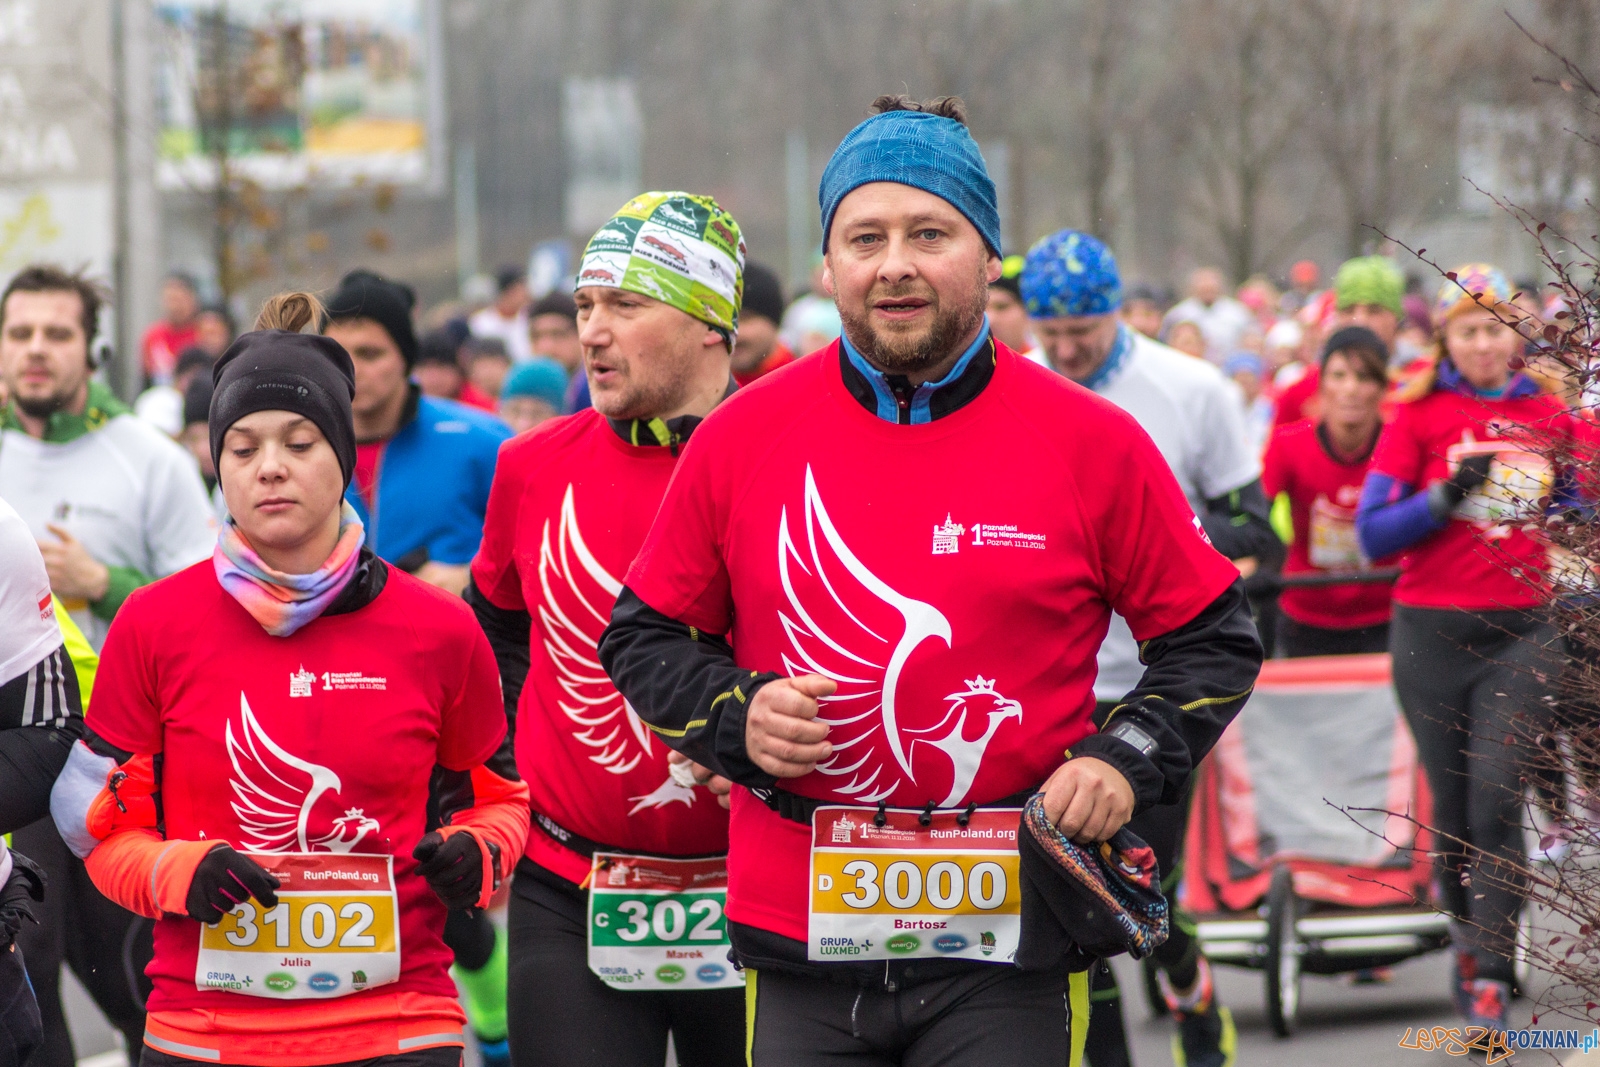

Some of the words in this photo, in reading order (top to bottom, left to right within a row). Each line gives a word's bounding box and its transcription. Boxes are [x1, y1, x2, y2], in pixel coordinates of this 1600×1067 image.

[982, 524, 1018, 532] Poznański
[970, 523, 984, 545] 1
[982, 531, 998, 539] Bieg
[998, 531, 1046, 541] Niepodległości
[1014, 540, 1046, 550] 11.11.2016
[321, 672, 334, 691] 1
[859, 822, 869, 839] 1
[930, 829, 1016, 841] RunPoland.org
[303, 870, 379, 883] RunPoland.org
[818, 874, 834, 891] D
[841, 860, 1008, 910] 3000
[224, 901, 376, 948] 3102
[616, 899, 729, 942] 302
[894, 919, 947, 930] Bartosz
[820, 937, 854, 946] GRUPA
[666, 950, 704, 959] Marek
[820, 946, 860, 955] LUXMED
[280, 957, 311, 967] Julia
[207, 971, 236, 982] GRUPA
[206, 980, 242, 990] LUXMED
